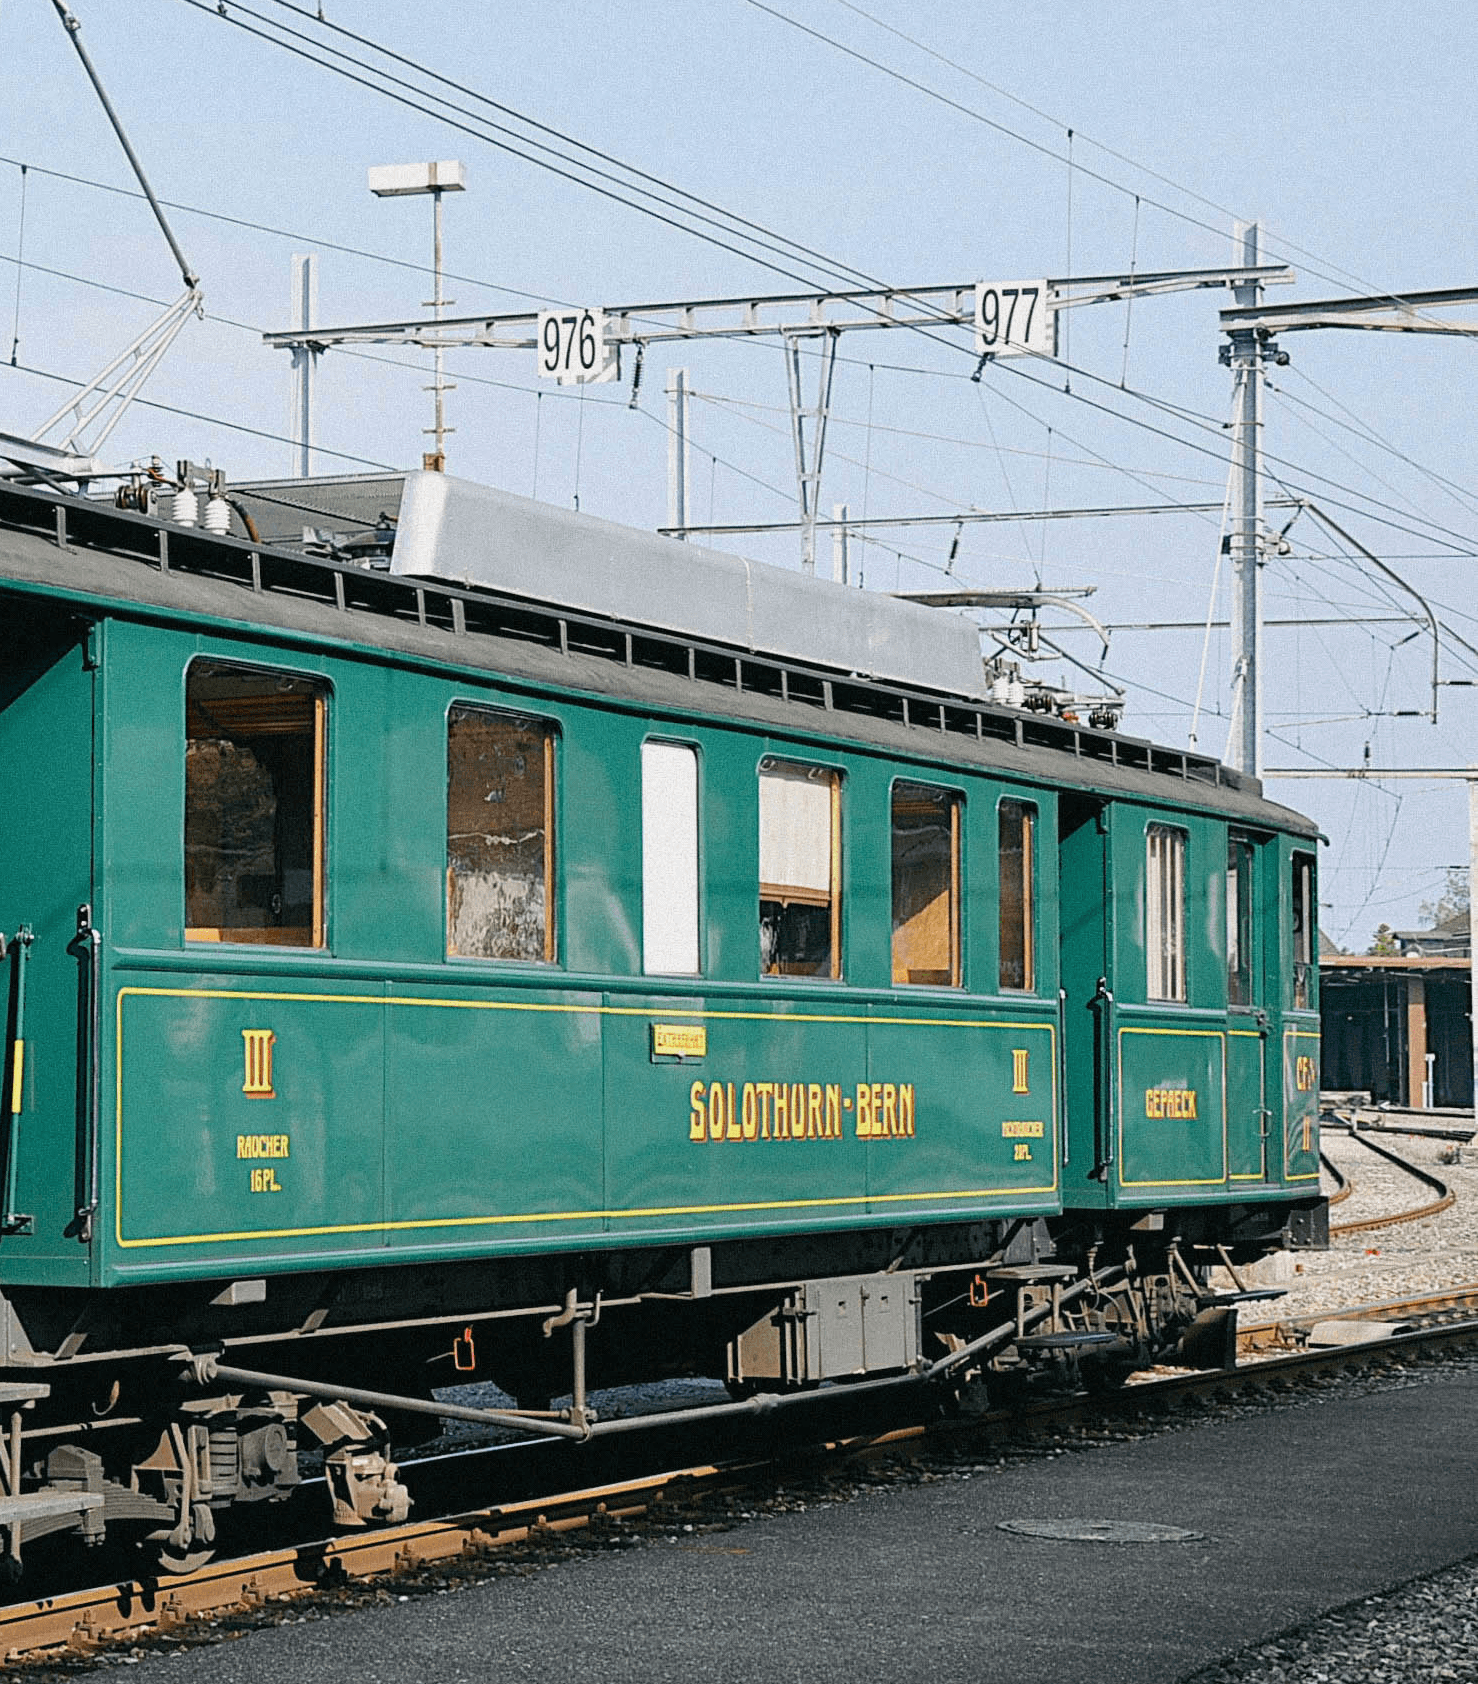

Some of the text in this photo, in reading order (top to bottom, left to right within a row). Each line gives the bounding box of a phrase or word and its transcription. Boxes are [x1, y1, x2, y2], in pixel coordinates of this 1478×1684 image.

[544, 314, 595, 371] 976
[982, 288, 1039, 345] 977
[241, 1029, 277, 1099] III
